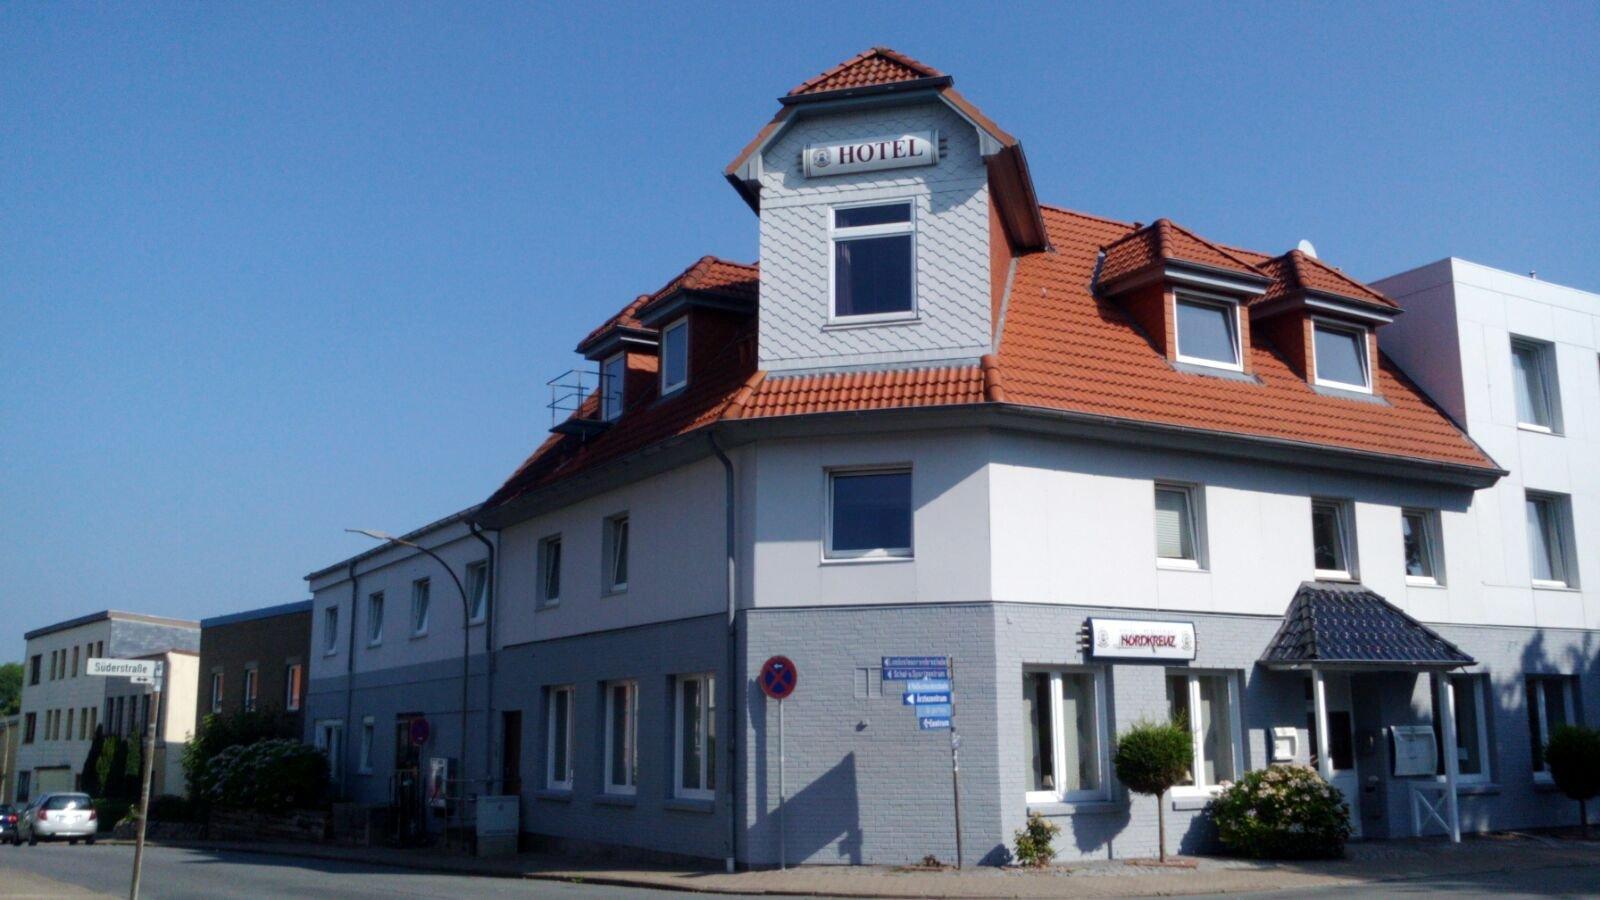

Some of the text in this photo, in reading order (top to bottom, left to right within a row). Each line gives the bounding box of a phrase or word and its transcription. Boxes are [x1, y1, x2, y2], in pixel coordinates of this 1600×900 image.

[839, 139, 923, 165] HOTEL
[1120, 634, 1176, 649] NORDKREUZ
[95, 662, 147, 673] Süderstraße
